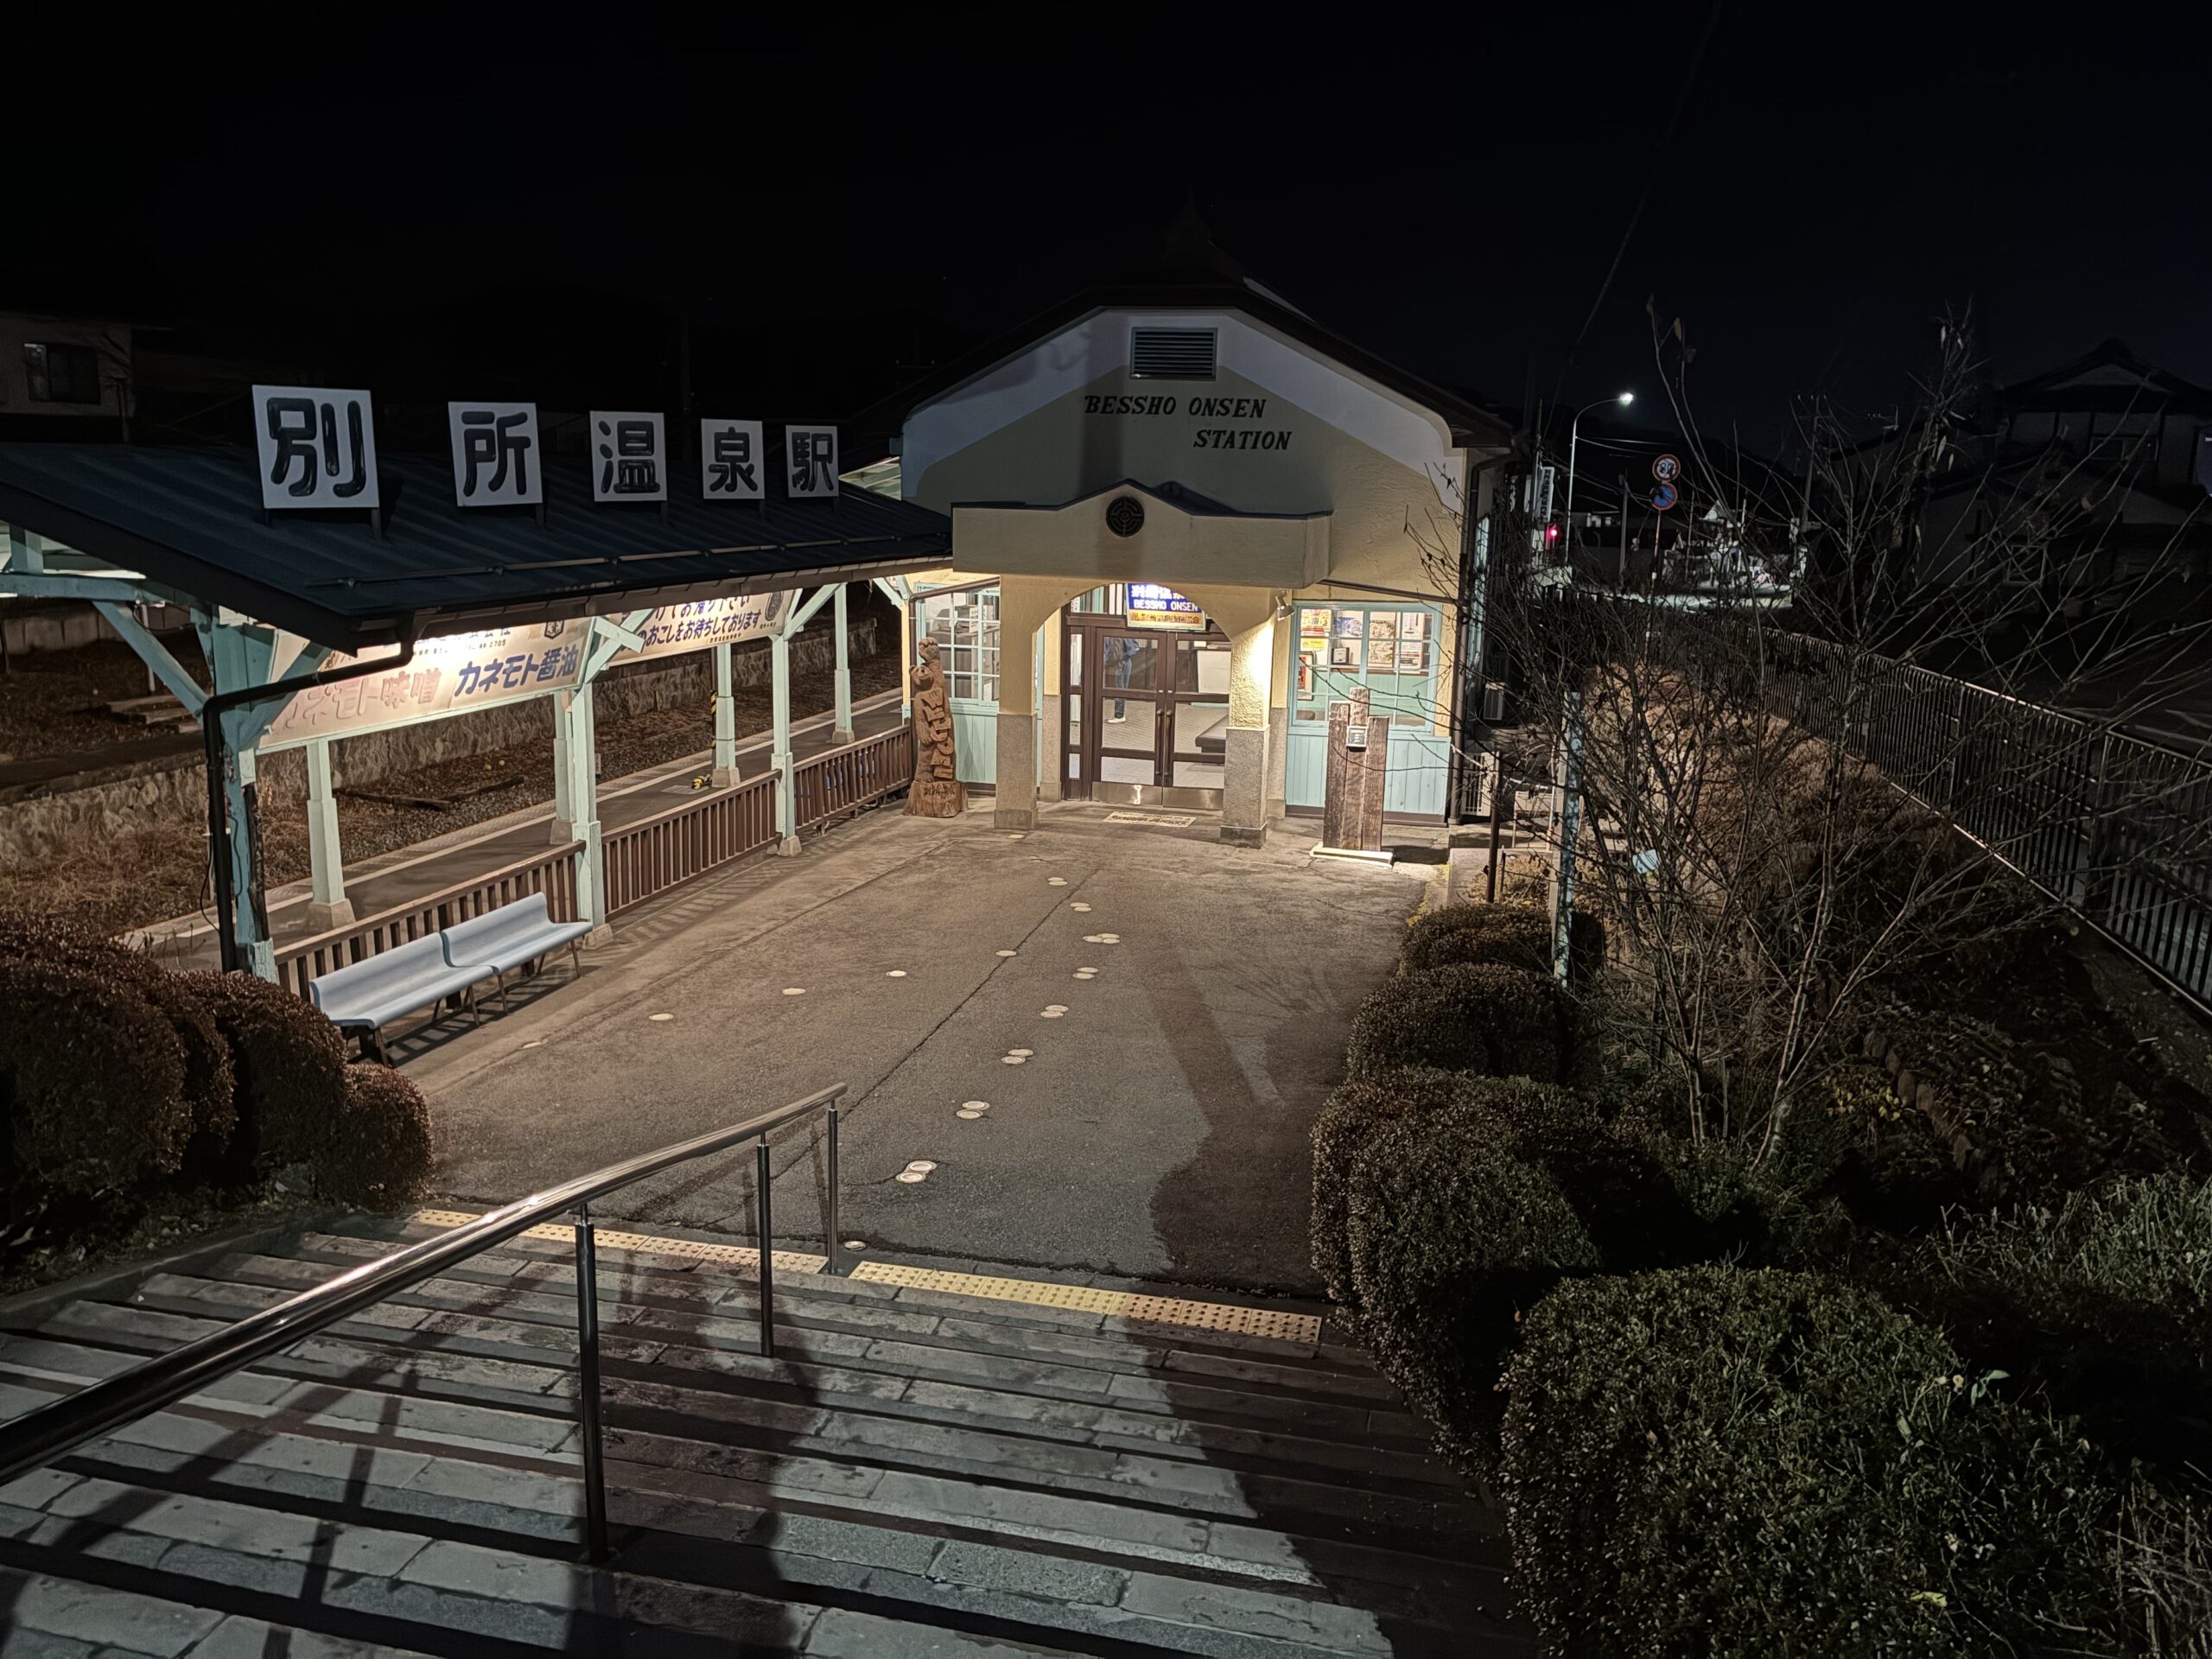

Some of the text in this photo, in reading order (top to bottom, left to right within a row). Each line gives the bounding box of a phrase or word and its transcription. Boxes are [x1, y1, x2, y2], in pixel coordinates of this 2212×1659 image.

[1084, 394, 1268, 418] BESSHO ONSEN
[266, 397, 836, 498] 別所温泉駅
[1193, 429, 1293, 450] STATION
[1171, 601, 1198, 612] ONSEN
[454, 644, 580, 697] カネモト醤油
